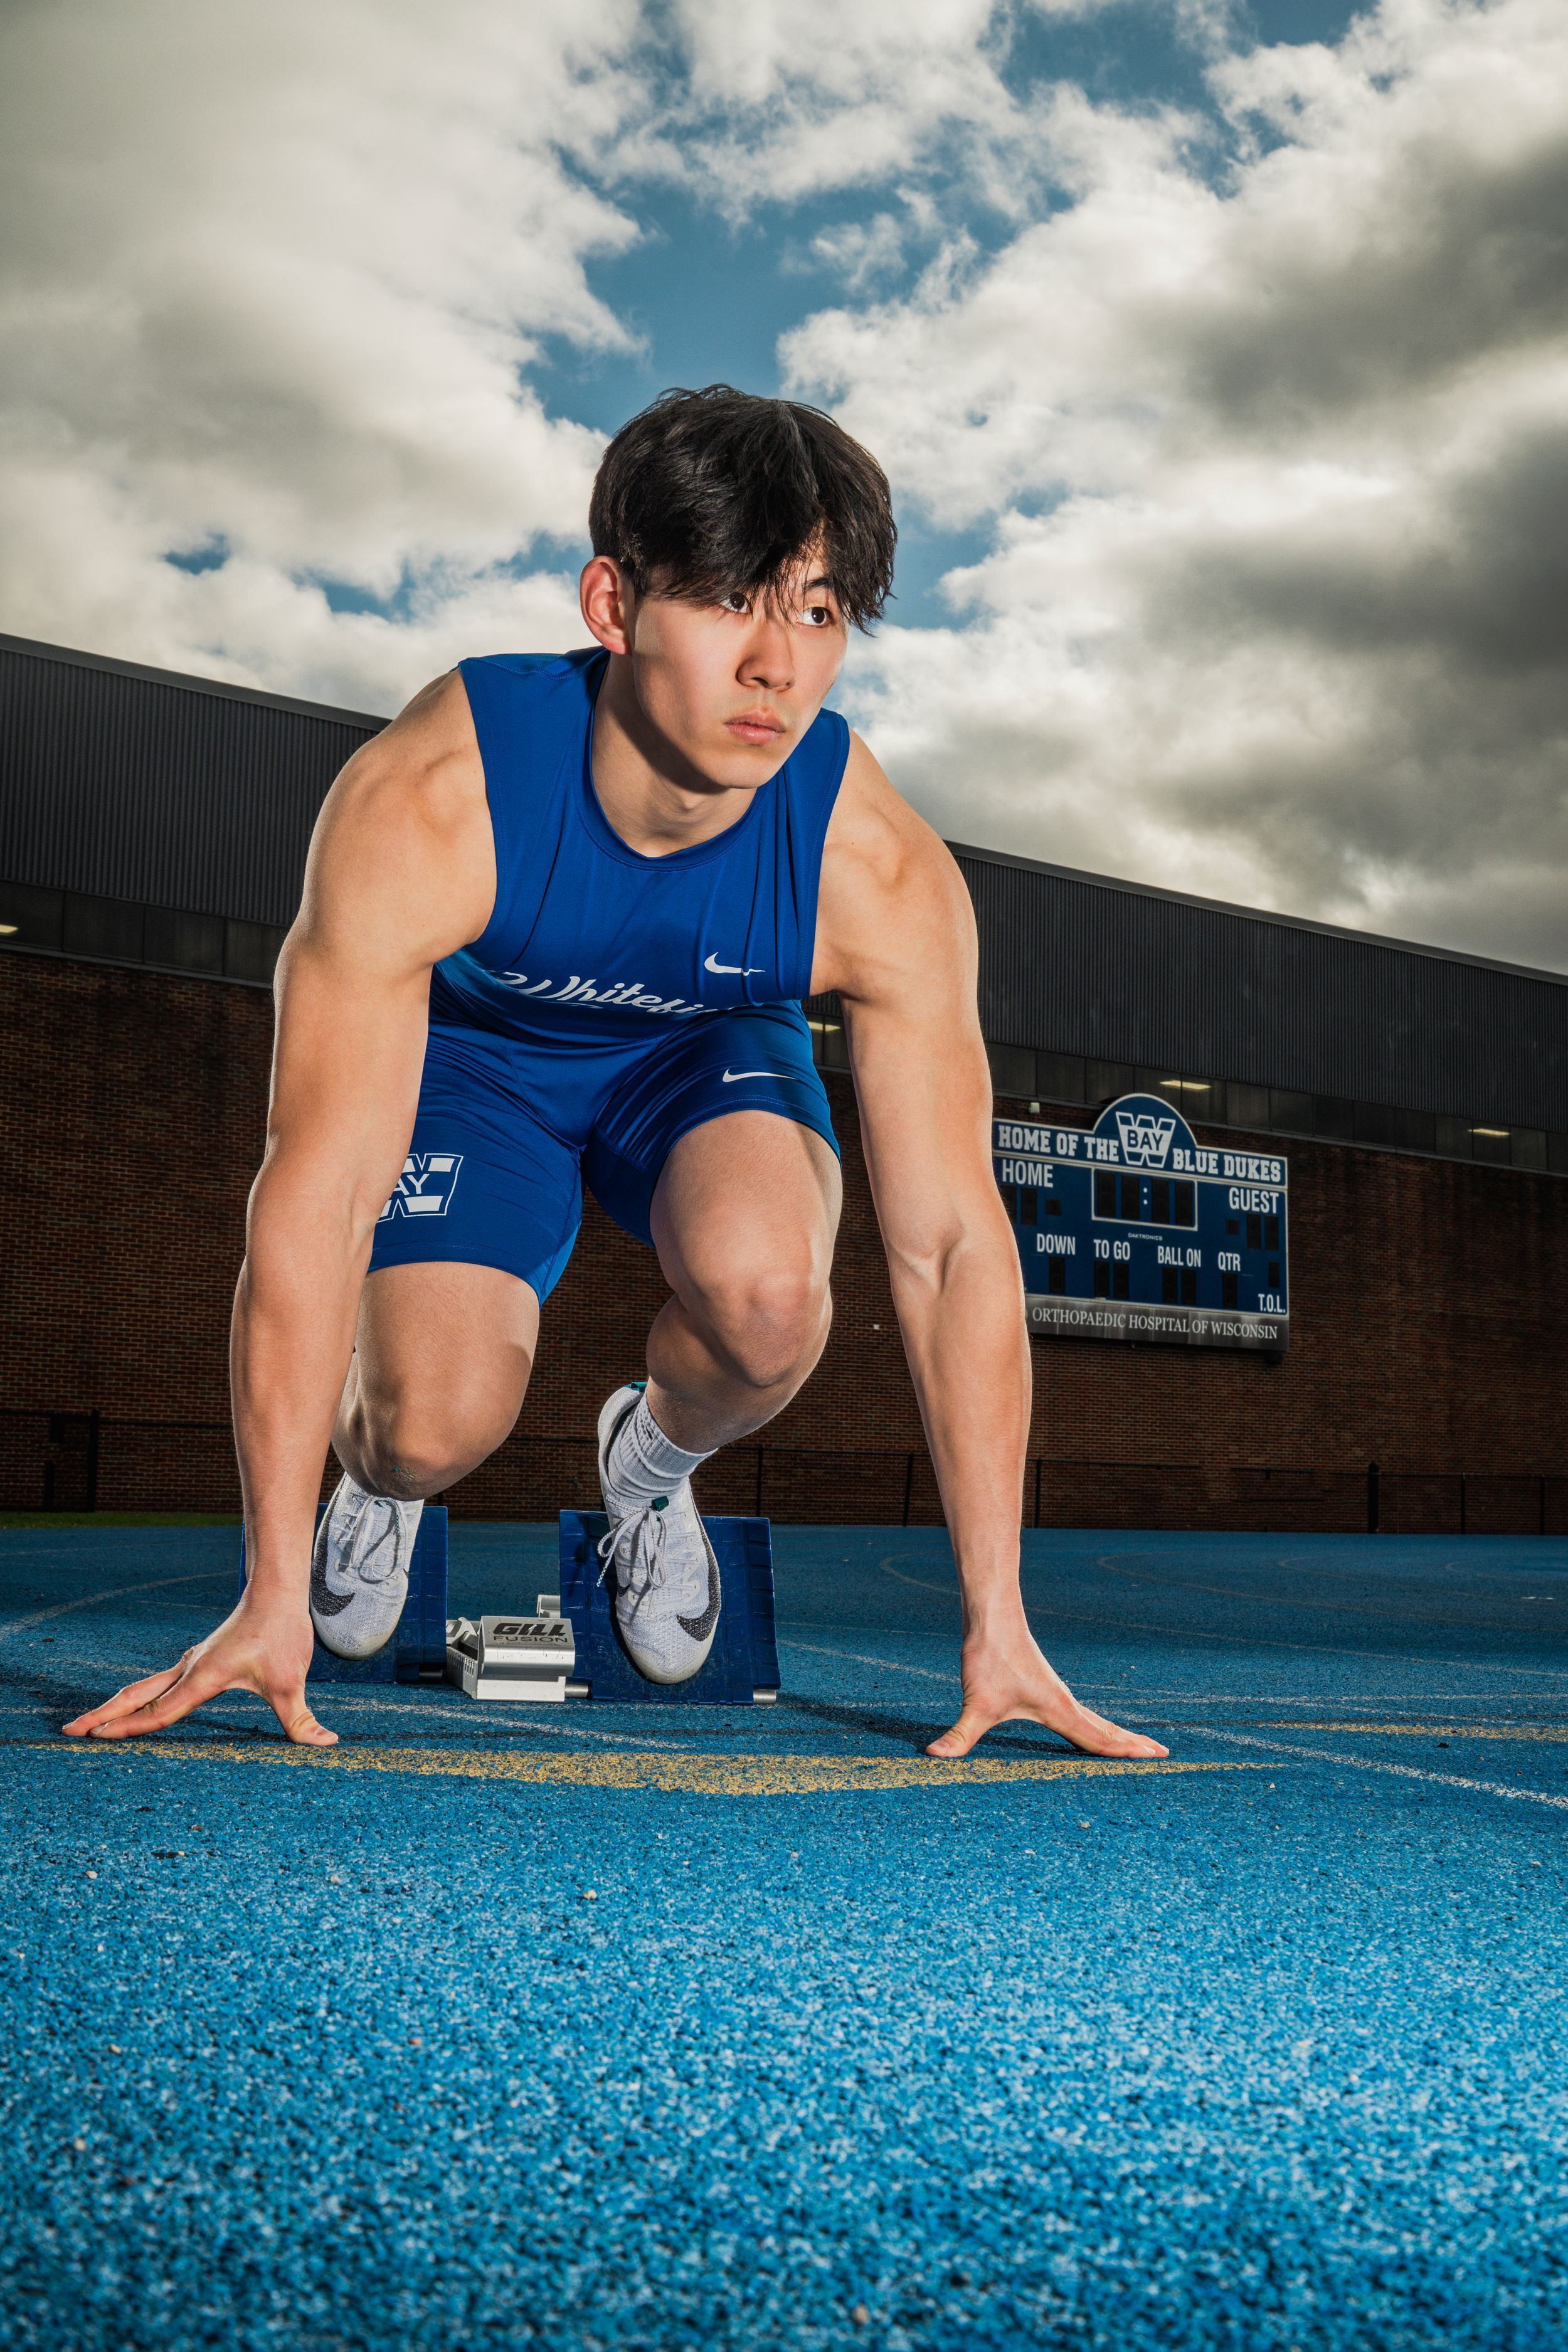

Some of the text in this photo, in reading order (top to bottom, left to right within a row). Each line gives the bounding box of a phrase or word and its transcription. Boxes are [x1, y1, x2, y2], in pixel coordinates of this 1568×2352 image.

[1128, 1128, 1164, 1152] BAY
[999, 1125, 1281, 1182] HOME OF THE BLUE DUKES
[1002, 1159, 1053, 1187] HOME
[1229, 1187, 1279, 1214] GUEST
[1036, 1233, 1076, 1255] DOWN
[1128, 1232, 1163, 1241] DAKTRONICS
[1093, 1239, 1131, 1261] TO GO
[1157, 1245, 1202, 1268] BALL ON
[1217, 1251, 1241, 1271] QTR
[1258, 1293, 1286, 1313] T.O.L.
[1032, 1307, 1126, 1328] ORTHOPAEDIC
[1129, 1315, 1190, 1333] HOSPITAL
[1192, 1319, 1209, 1334] OF
[1211, 1321, 1278, 1340] WISCONSIN
[493, 1623, 566, 1636] GILL
